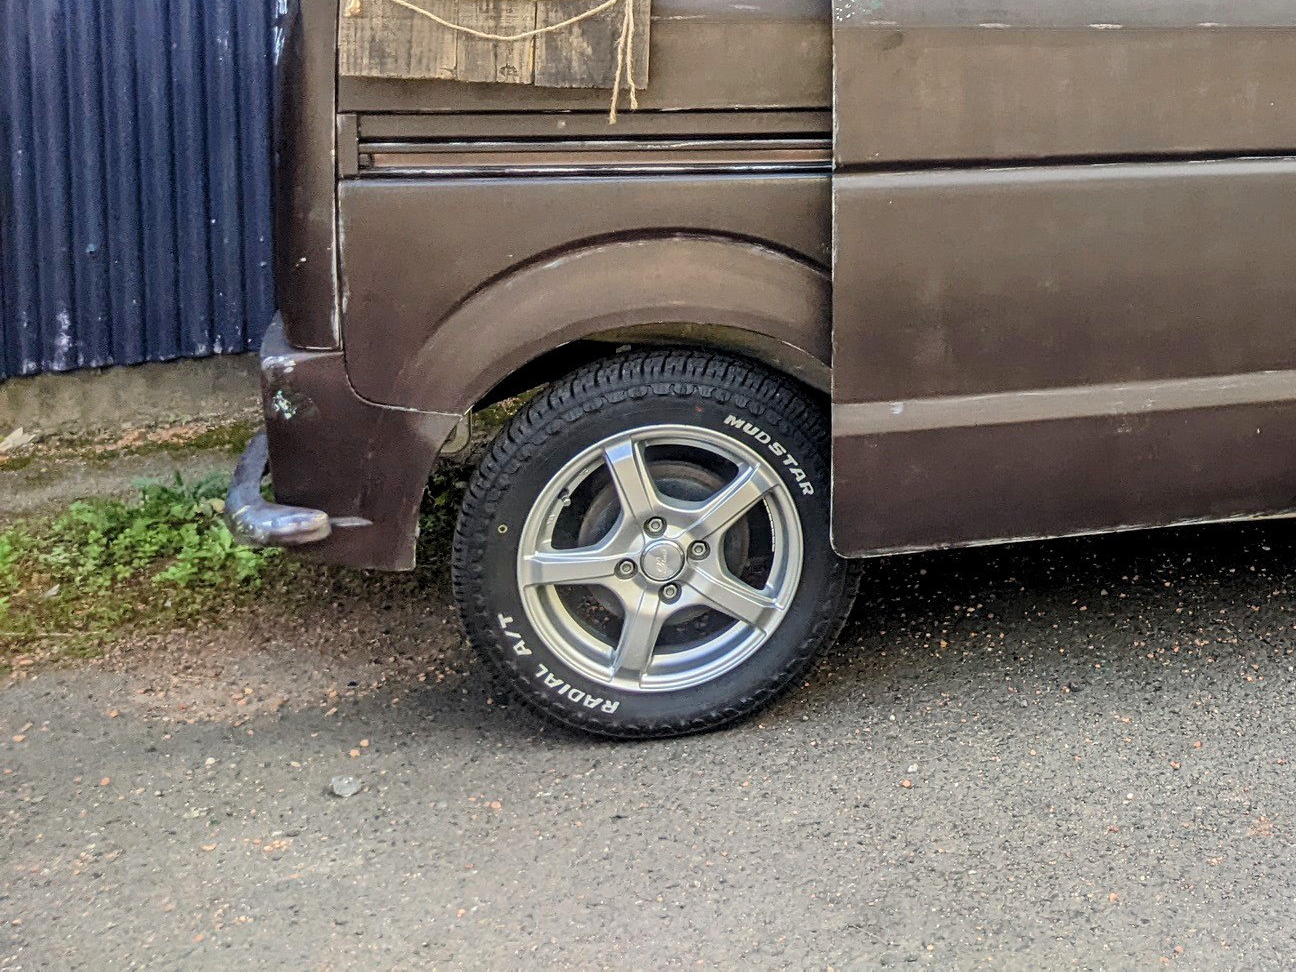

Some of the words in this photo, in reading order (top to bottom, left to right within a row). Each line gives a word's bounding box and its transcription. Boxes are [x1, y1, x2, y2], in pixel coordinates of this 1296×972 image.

[724, 414, 815, 497] MUDSTAR
[497, 613, 533, 656] A/T
[536, 664, 621, 715] RADIAL
